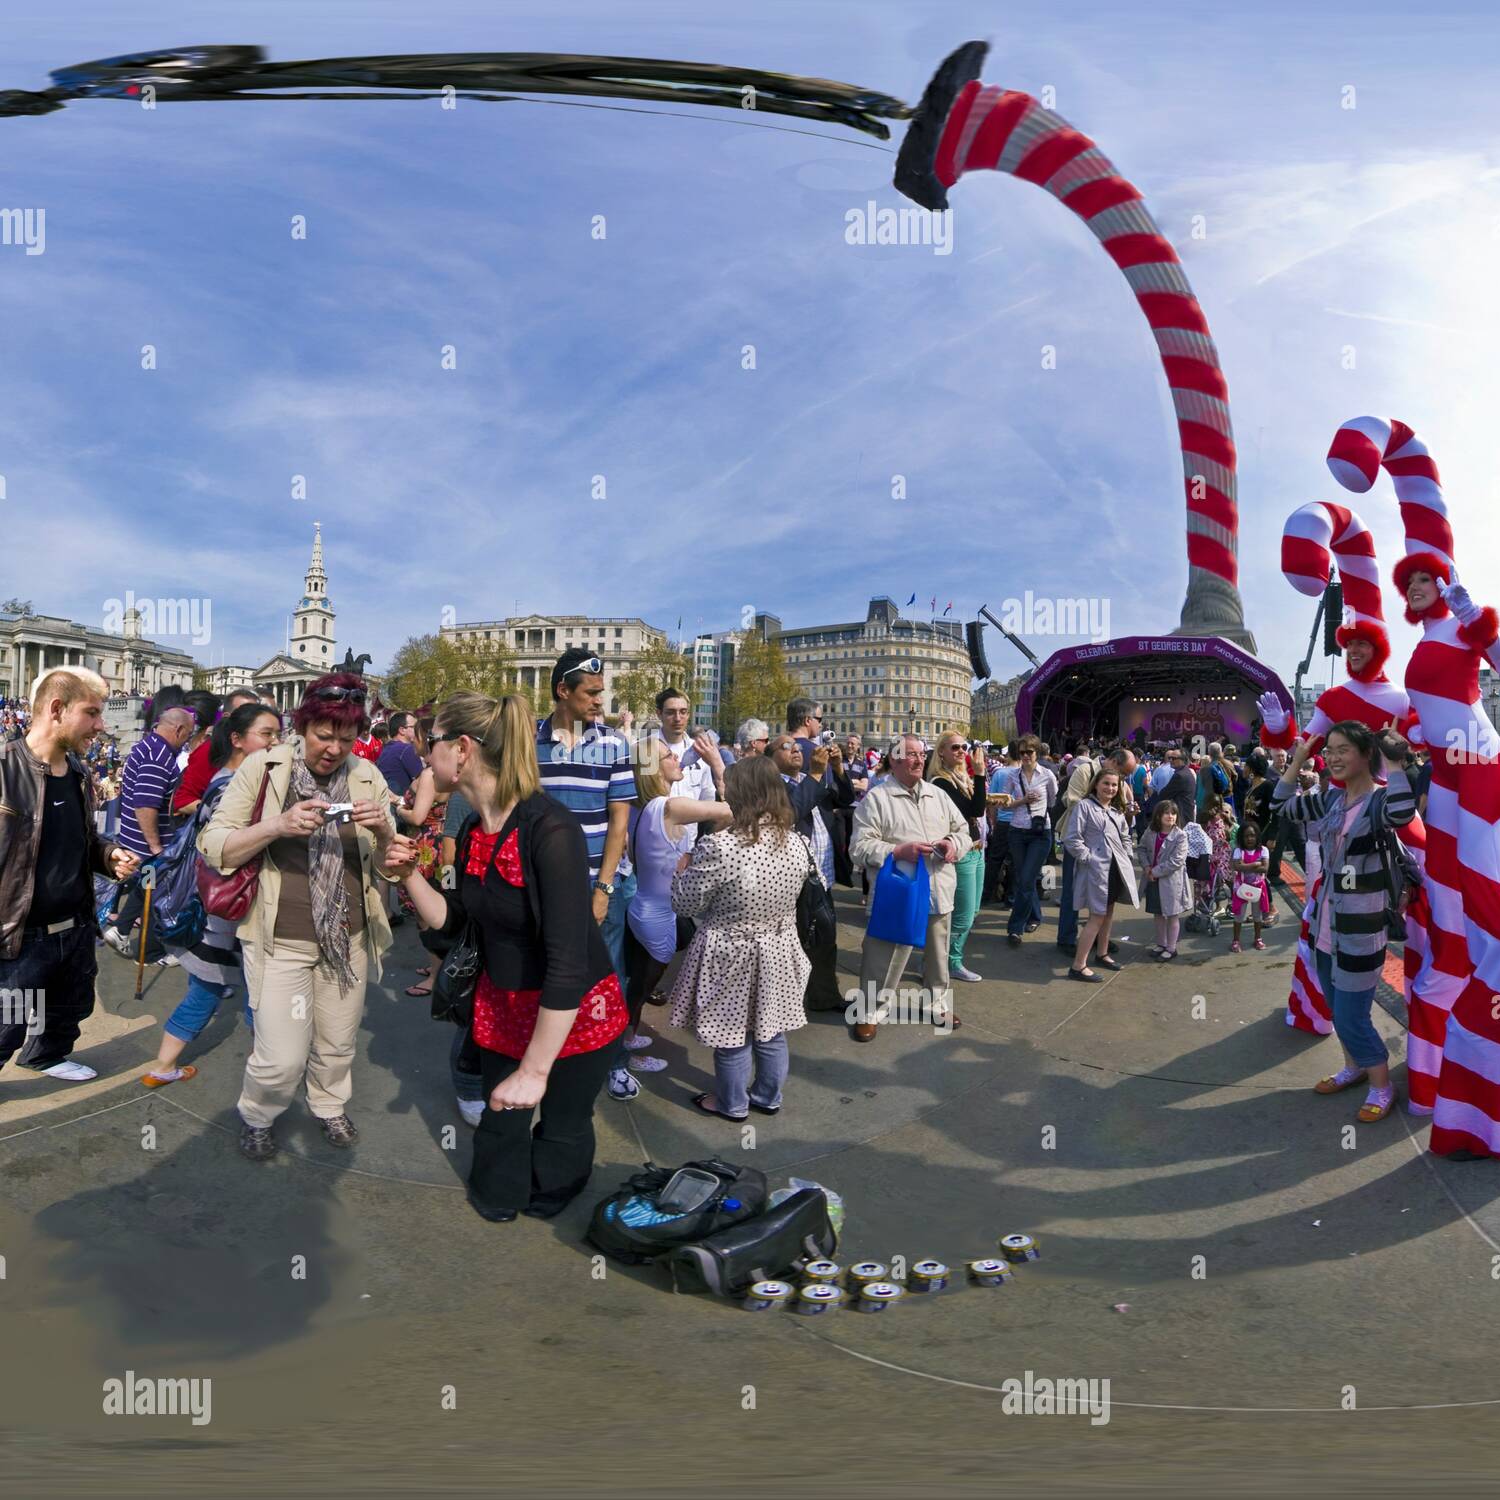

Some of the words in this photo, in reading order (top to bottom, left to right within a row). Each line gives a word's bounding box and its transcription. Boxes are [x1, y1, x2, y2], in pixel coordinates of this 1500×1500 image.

[1075, 644, 1116, 659] CELEBRATE
[1138, 641, 1149, 650] ST
[1151, 641, 1189, 652] GEORGE'S
[1192, 642, 1208, 652] DAY
[1213, 645, 1234, 660] MAYOR
[1233, 657, 1243, 665] OF
[1242, 662, 1268, 681] LONDON
[1154, 717, 1221, 735] Rhythm
